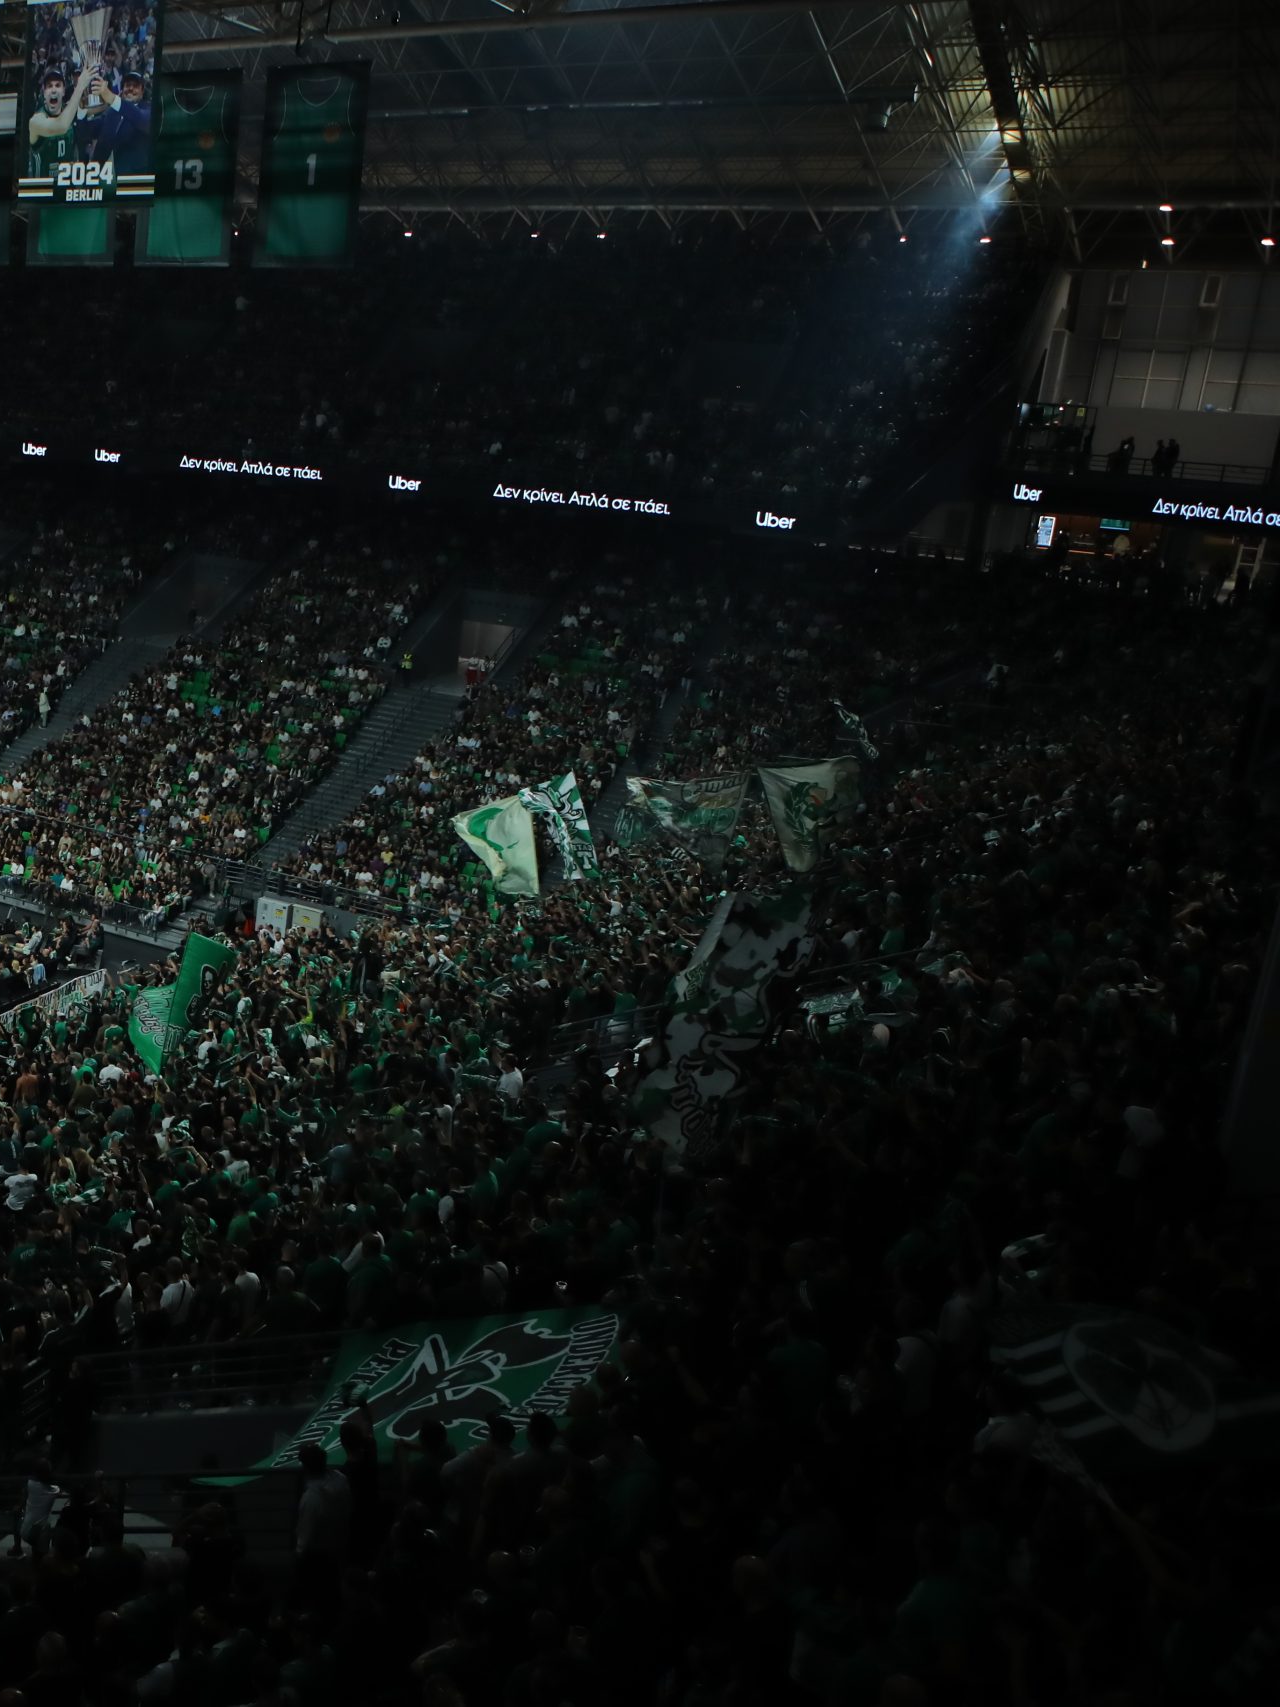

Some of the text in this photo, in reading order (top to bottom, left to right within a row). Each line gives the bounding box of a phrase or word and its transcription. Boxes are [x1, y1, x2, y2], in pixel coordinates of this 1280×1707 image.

[57, 161, 114, 186] 2024
[173, 159, 204, 189] 13
[306, 153, 317, 185] 1
[66, 189, 103, 202] BERLIN
[22, 442, 47, 456] Uber
[94, 449, 121, 463] Uber
[180, 455, 202, 469] Δεν
[240, 461, 272, 475] Απλά
[275, 466, 291, 477] σε
[388, 475, 421, 491] Uber
[1013, 484, 1043, 502] Uber
[493, 484, 521, 500] Δεν
[568, 491, 609, 509] Απλά
[612, 498, 631, 511] σε
[756, 511, 796, 530] Uber
[1152, 498, 1179, 515] Δεν
[1222, 505, 1264, 525] Απλά
